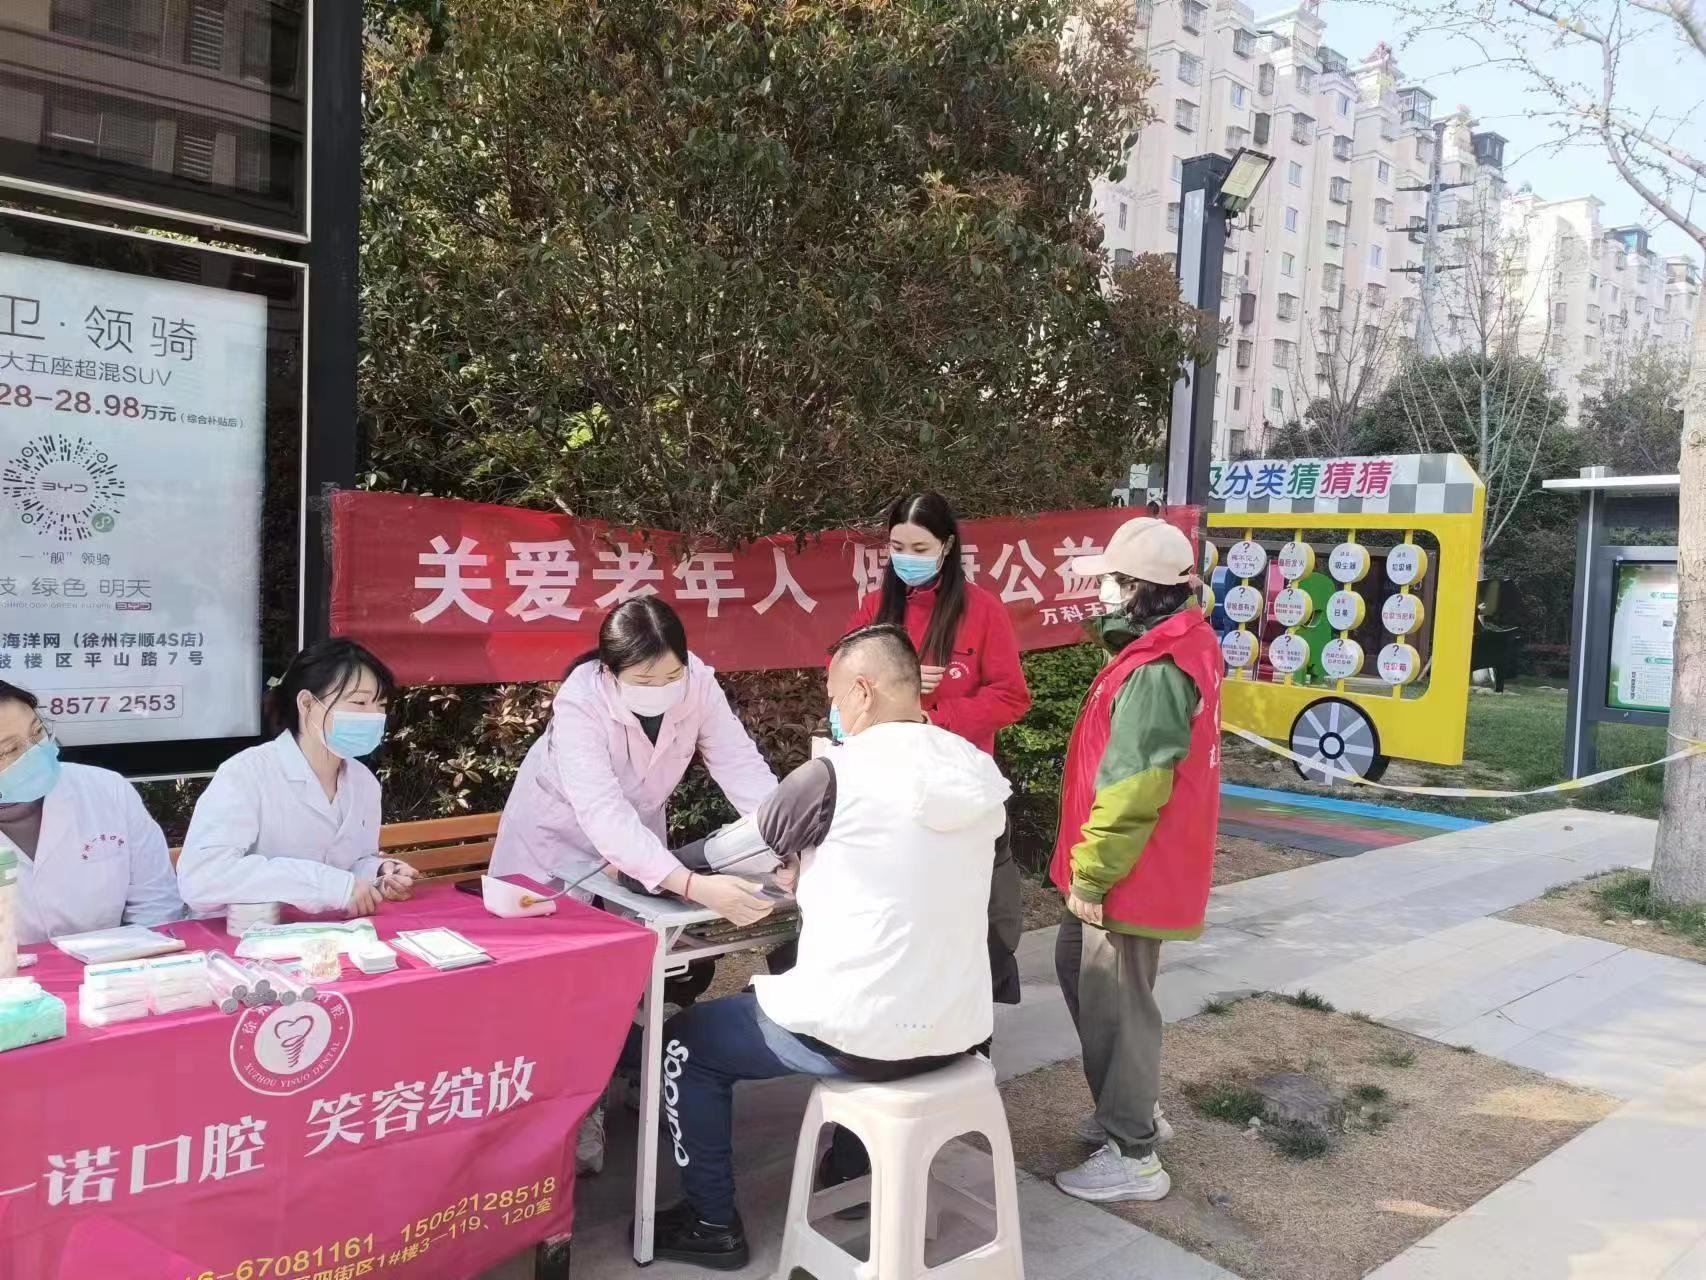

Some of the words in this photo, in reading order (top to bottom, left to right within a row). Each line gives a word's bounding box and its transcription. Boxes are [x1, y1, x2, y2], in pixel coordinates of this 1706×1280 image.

[31, 576, 88, 598] 绿色
[99, 578, 152, 598] 明天
[413, 535, 818, 624] 关爱老年人
[119, 694, 176, 713] 2553
[243, 1062, 277, 1087] XUZHOU
[280, 1073, 310, 1088] YINUO
[312, 1041, 341, 1075] DENTAL
[304, 1056, 537, 1157] 笑容绽放
[664, 1039, 690, 1167] adidas
[400, 1176, 556, 1243] 15062128518
